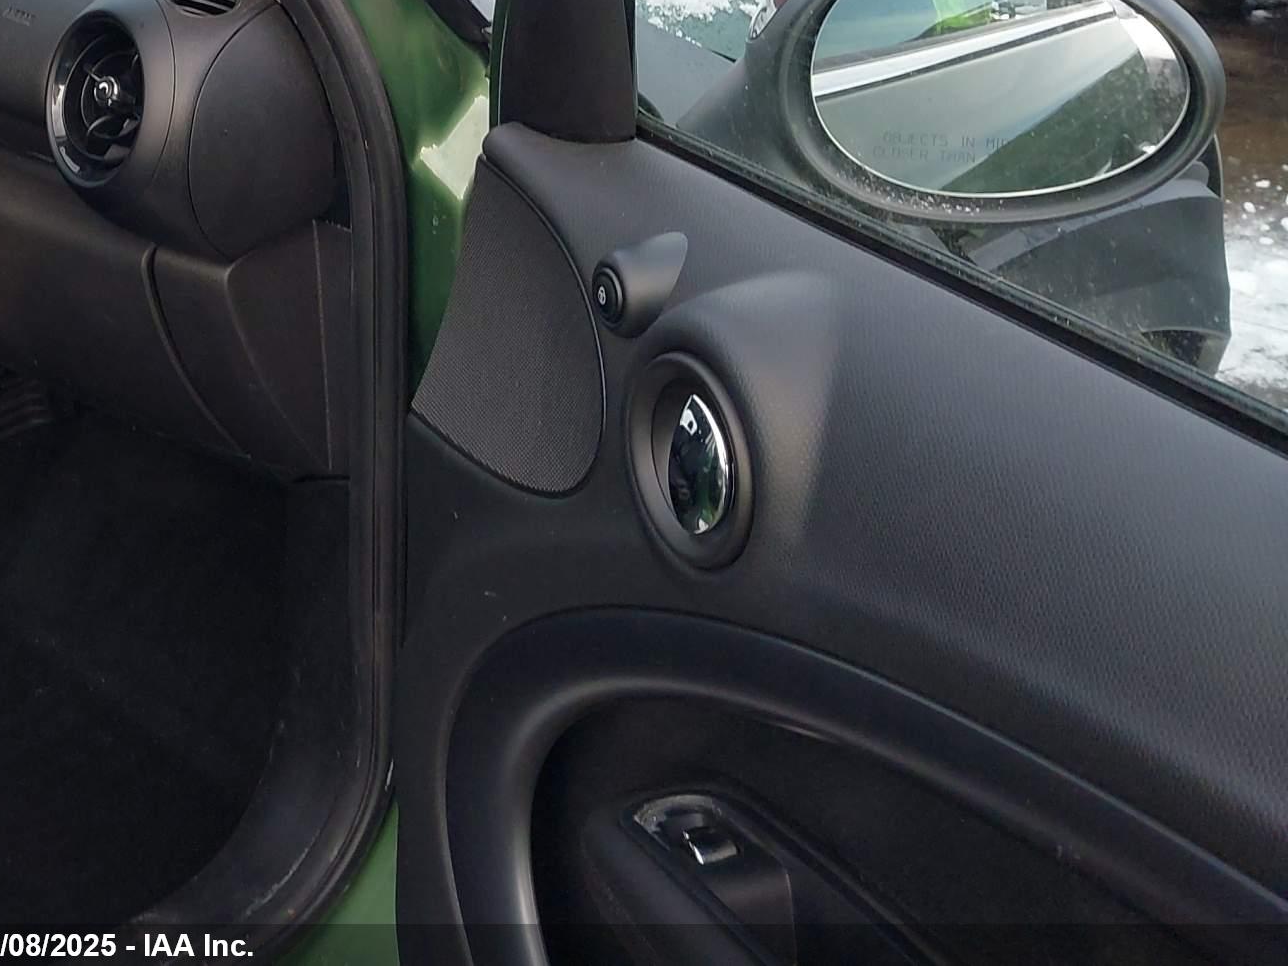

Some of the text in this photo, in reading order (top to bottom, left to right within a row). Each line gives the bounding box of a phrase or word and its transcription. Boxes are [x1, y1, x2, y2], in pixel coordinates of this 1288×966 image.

[882, 132, 948, 146] OBJECTS
[961, 137, 976, 147] IN
[873, 146, 976, 163] CLOSER THAN
